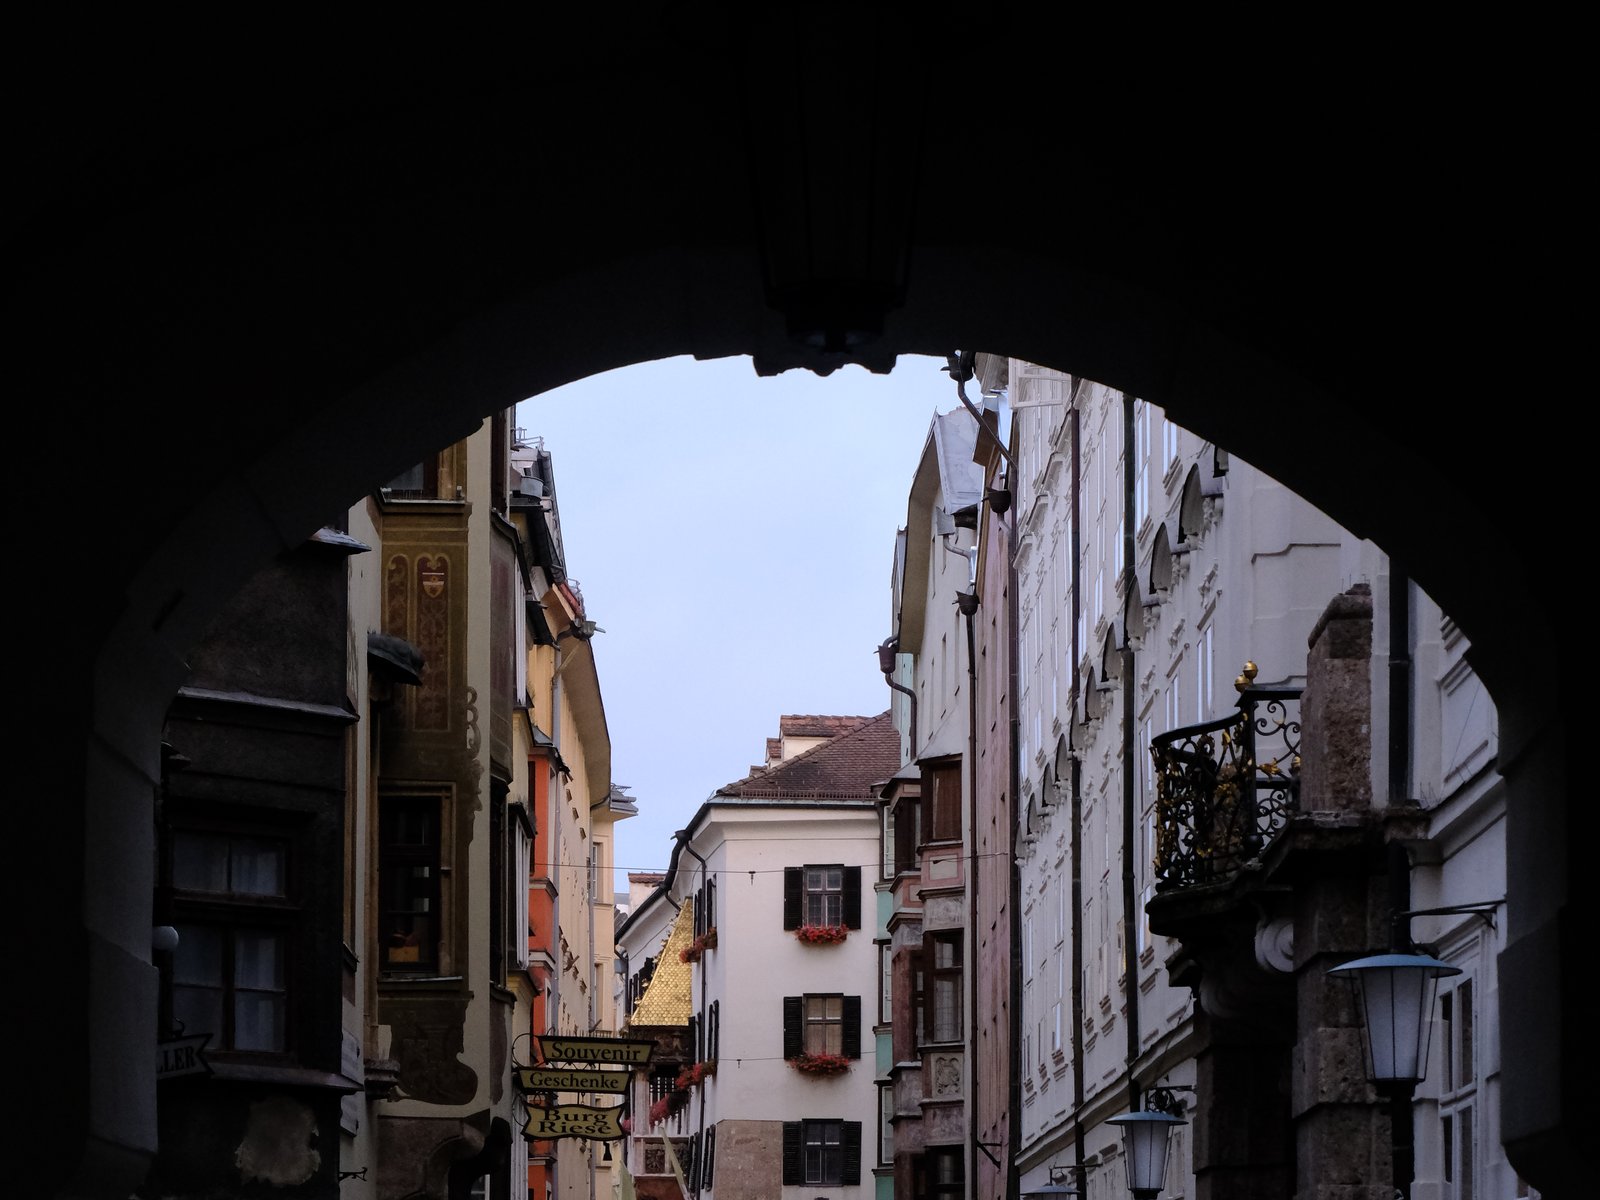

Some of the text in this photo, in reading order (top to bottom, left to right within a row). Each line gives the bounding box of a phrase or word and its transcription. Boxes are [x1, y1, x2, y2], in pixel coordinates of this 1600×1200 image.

[551, 1041, 641, 1060] Souvenir
[529, 1072, 619, 1089] Geschenke
[544, 1109, 609, 1126] Burg
[538, 1120, 612, 1135] Riese
